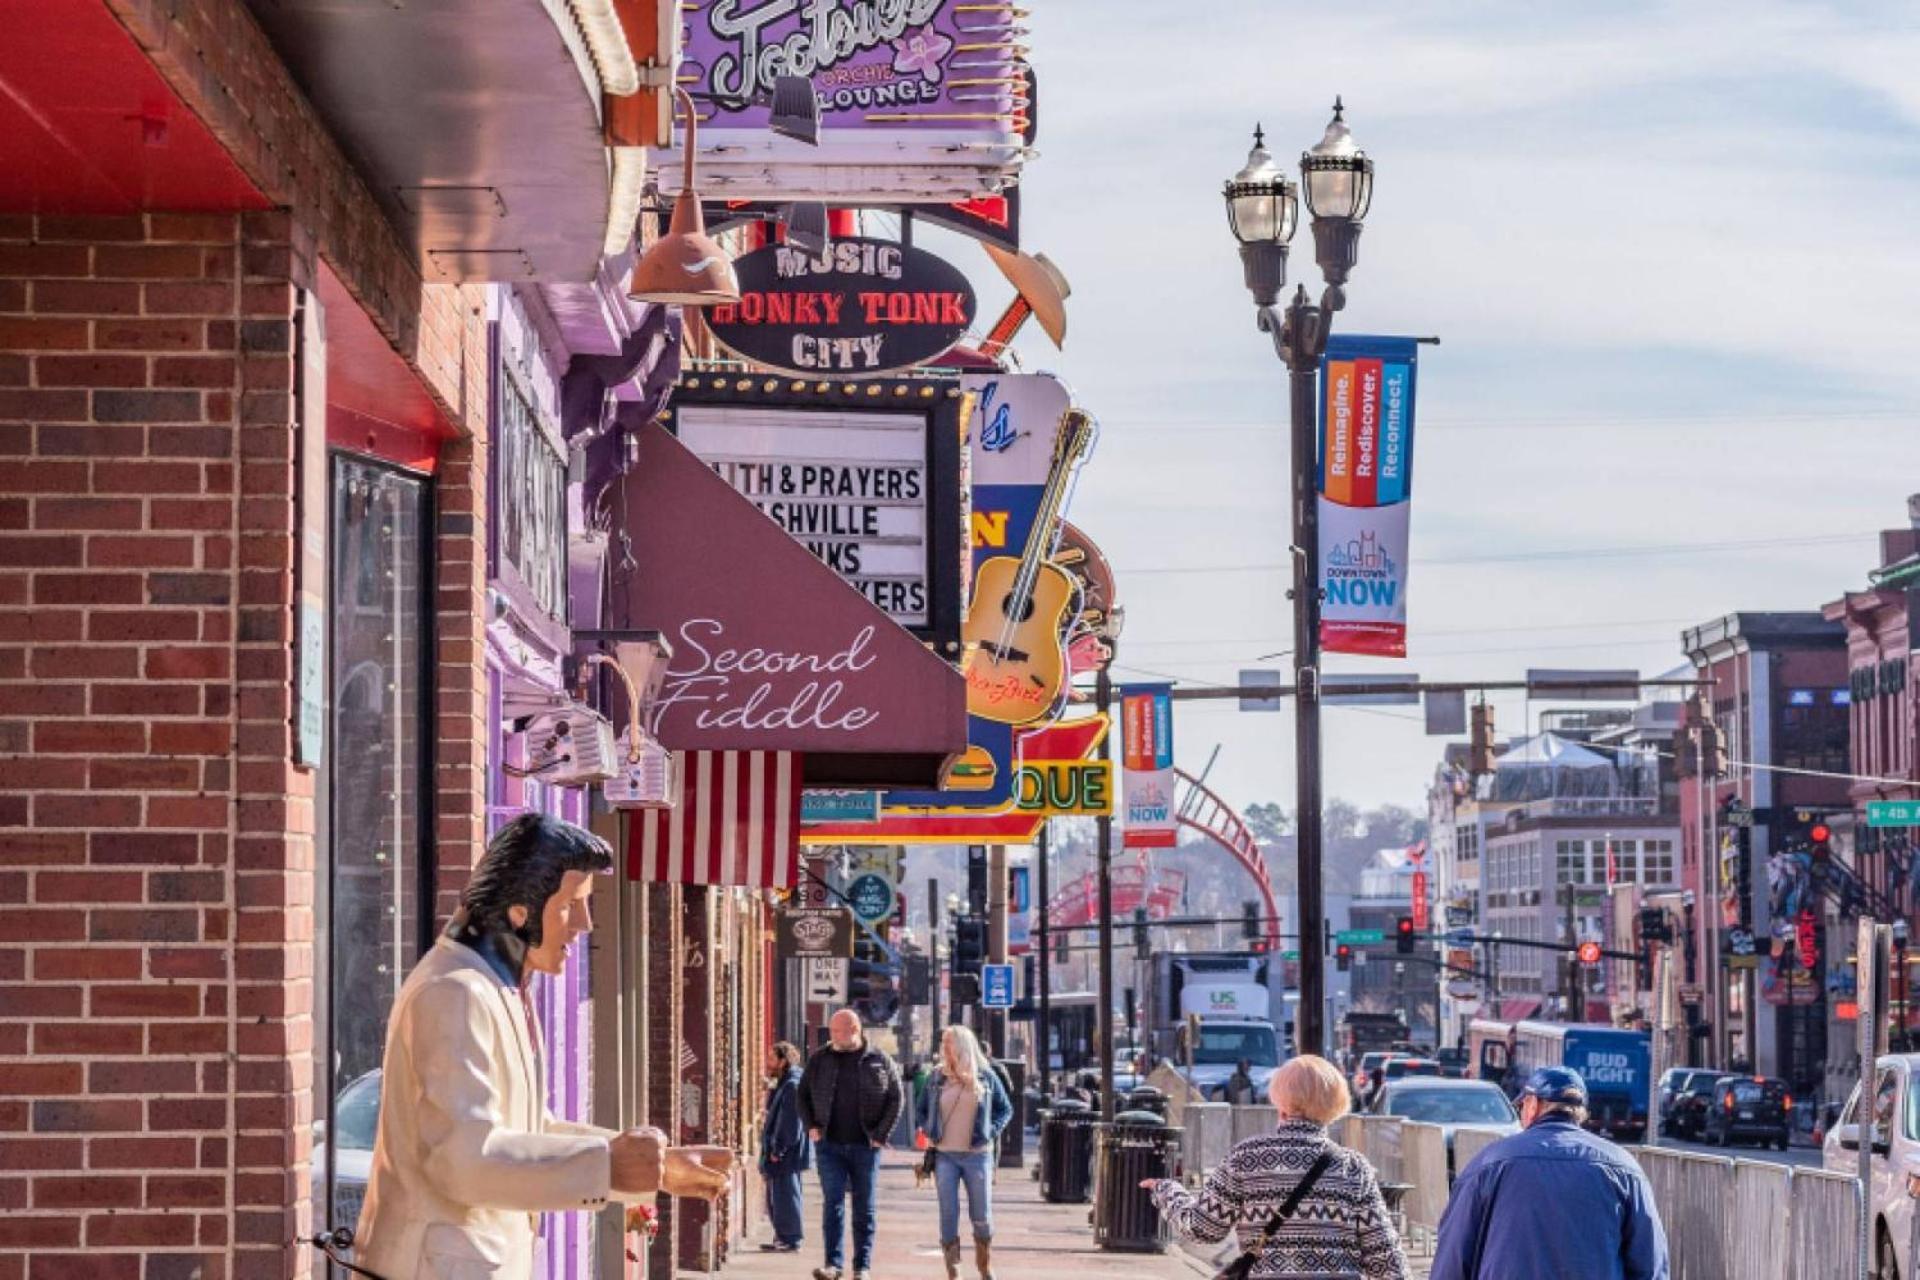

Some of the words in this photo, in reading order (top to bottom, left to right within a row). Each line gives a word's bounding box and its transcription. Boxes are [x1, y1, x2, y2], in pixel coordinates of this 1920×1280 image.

[816, 81, 938, 108] LOUNGE
[712, 290, 844, 325] HONKY
[859, 291, 968, 324] TONK
[792, 333, 887, 369] CITY
[1331, 373, 1349, 477] Reimagine.
[1356, 368, 1377, 477] Rediscover.
[1382, 373, 1403, 478] Reconnect.
[780, 465, 796, 494] &
[802, 465, 920, 499] PRAYERS
[757, 502, 878, 535] SHVILLE
[1327, 567, 1387, 578] DOWNTOWN
[1327, 579, 1397, 606] NOW
[666, 618, 878, 677] Second
[654, 675, 880, 735] Fiddle
[1012, 766, 1106, 810] QUE
[1128, 807, 1168, 822] NOW
[814, 971, 841, 981] WAY
[1210, 991, 1236, 1004] US
[1580, 1066, 1636, 1084] LIGHT
[1588, 1051, 1628, 1068] BUD
